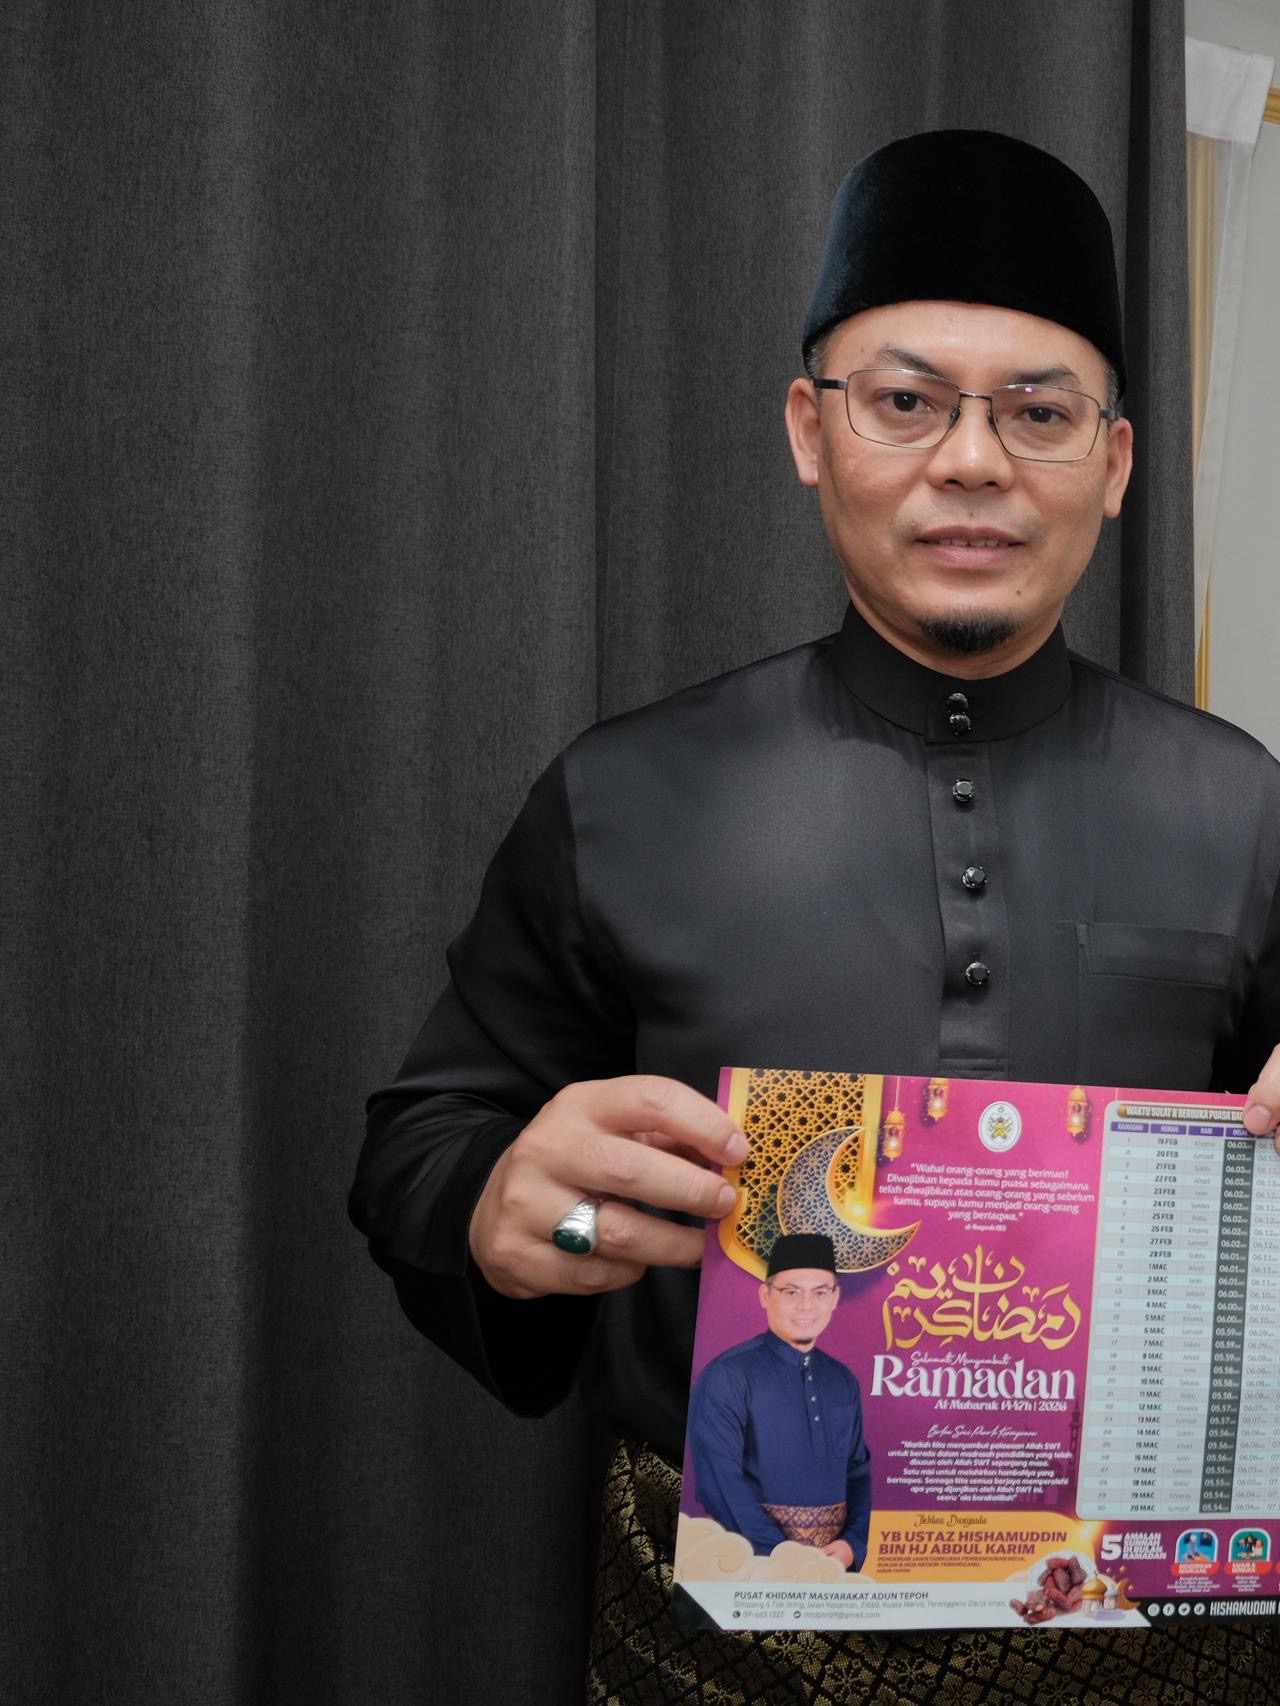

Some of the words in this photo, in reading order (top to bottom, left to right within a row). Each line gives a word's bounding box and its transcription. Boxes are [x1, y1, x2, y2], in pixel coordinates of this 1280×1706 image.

[1126, 1105, 1150, 1115] WAKTU
[1150, 1106, 1172, 1116] SOLAT
[1172, 1108, 1178, 1118] &
[1178, 1108, 1208, 1119] BERBUKA
[1209, 1110, 1231, 1120] PUASA
[1157, 1137, 1164, 1145] 19
[910, 1163, 944, 1174] "Wahai
[946, 1165, 1002, 1178] orang-orang
[1004, 1168, 1027, 1179] yang
[1028, 1168, 1069, 1179] beriman!
[887, 1173, 937, 1184] Diwajibkan
[939, 1176, 972, 1186] kepada
[975, 1178, 1000, 1186] kamu
[1001, 1180, 1028, 1188] puasa
[1030, 1180, 1089, 1191] sebagaimana
[879, 1185, 902, 1194] telah
[904, 1186, 952, 1198] diwajibkan
[975, 1190, 1031, 1201] orang-orang
[1033, 1193, 1055, 1202] yang
[1057, 1192, 1095, 1202] sebelum
[894, 1196, 921, 1206] kamu,
[924, 1200, 955, 1209] supaya
[958, 1198, 983, 1208] kamu
[985, 1200, 1021, 1211] menjadi
[1023, 1203, 1080, 1214] orang-orang
[948, 1211, 972, 1221] yang
[973, 1211, 1023, 1222] bertaqwa."
[910, 1351, 951, 1366] Selamat
[952, 1352, 1012, 1368] Menyambut
[870, 1354, 1076, 1400] Ramadan
[934, 1399, 948, 1410] Al
[949, 1400, 998, 1411] Mubarak
[1001, 1400, 1032, 1412] 1447h
[1038, 1401, 1067, 1412] 2026
[946, 1515, 987, 1527] Daripada
[880, 1531, 900, 1542] YB
[904, 1531, 955, 1542] USTAZ
[958, 1531, 1067, 1542] HISHAMUDDIN
[879, 1544, 905, 1554] BIN
[908, 1544, 926, 1554] HJ
[930, 1544, 981, 1554] ABDUL
[985, 1544, 1036, 1554] KARIM
[1100, 1534, 1122, 1560] 5
[872, 1592, 897, 1600] ADUN
[1210, 1601, 1276, 1616] HISHAMUDDIN
